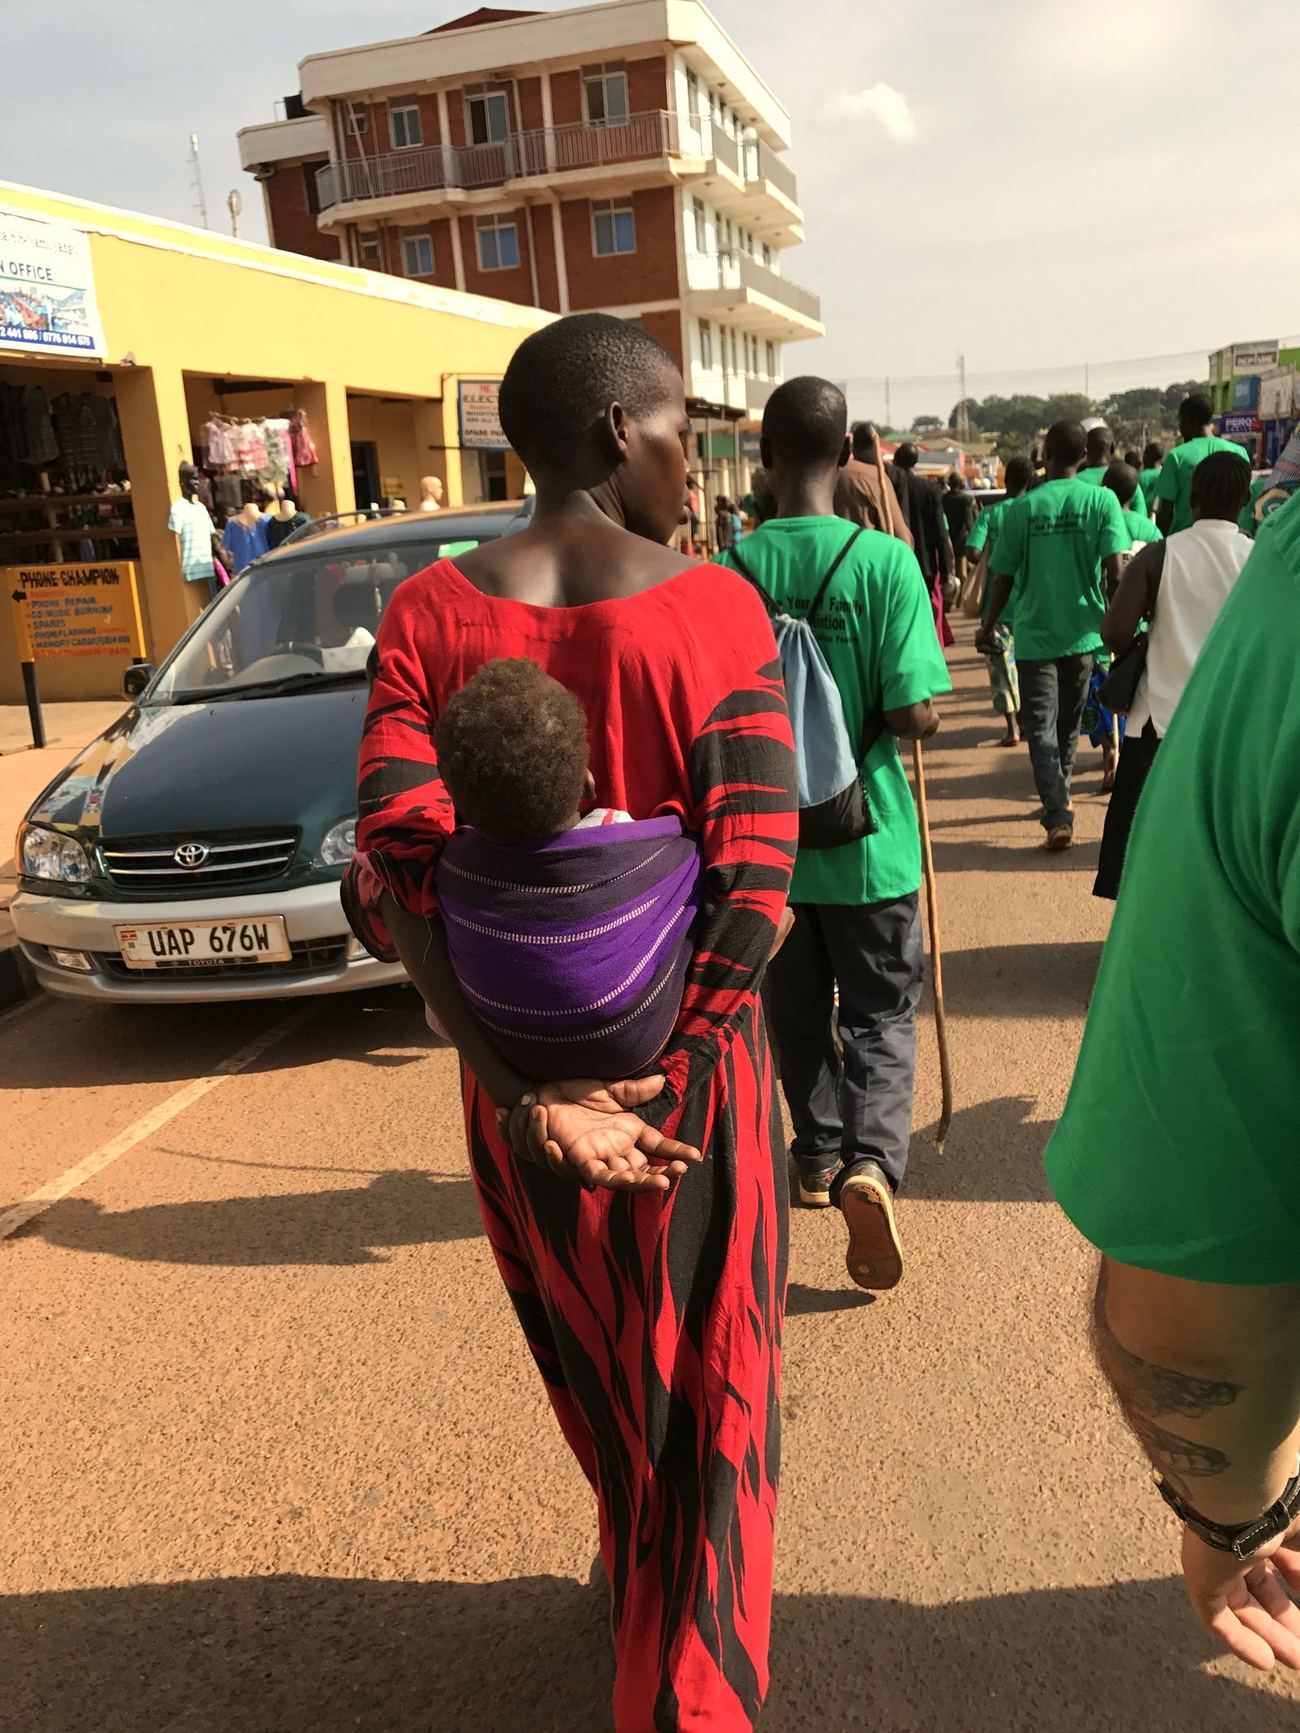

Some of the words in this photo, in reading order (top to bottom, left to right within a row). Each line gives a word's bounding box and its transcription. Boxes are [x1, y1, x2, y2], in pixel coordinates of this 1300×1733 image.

[9, 261, 53, 281] OFFICE
[463, 395, 498, 404] ELECT
[20, 571, 58, 589] PHONE
[60, 568, 119, 586] CHAMPION
[64, 597, 97, 606] REPAIR
[33, 619, 66, 630] SPARES
[147, 927, 195, 957] UAP
[209, 923, 270, 953] 676W
[187, 959, 225, 967] TOYOTA
